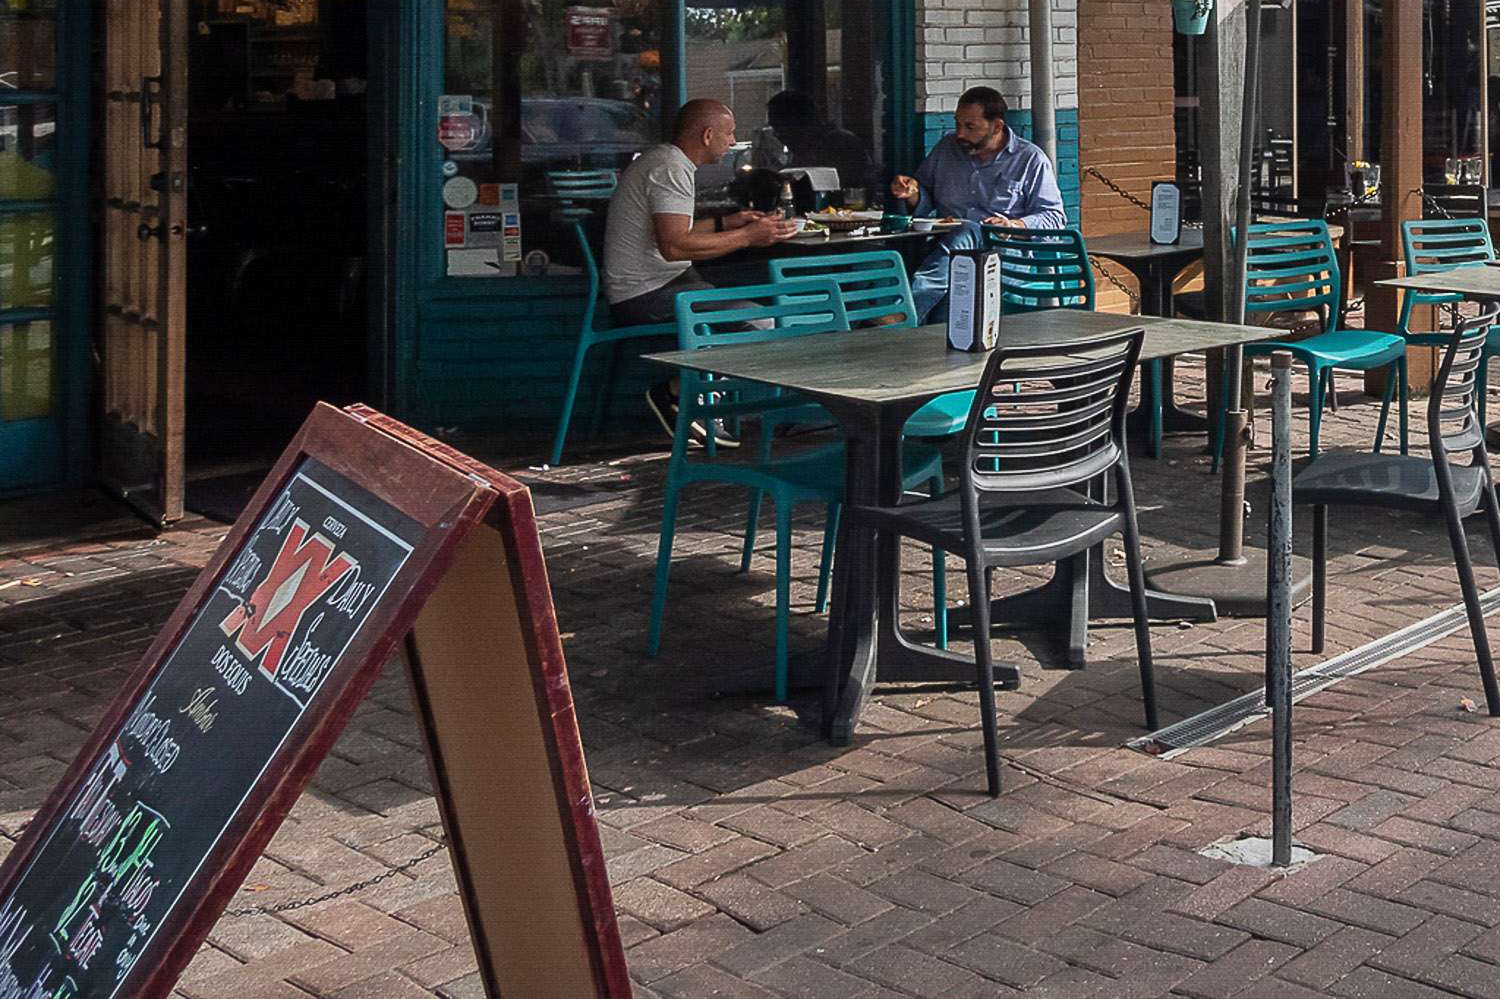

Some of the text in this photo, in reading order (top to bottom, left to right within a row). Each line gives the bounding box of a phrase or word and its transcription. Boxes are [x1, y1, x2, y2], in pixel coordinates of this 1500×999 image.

[322, 516, 348, 539] CERVEZA
[210, 644, 253, 696] DOS EQUIS
